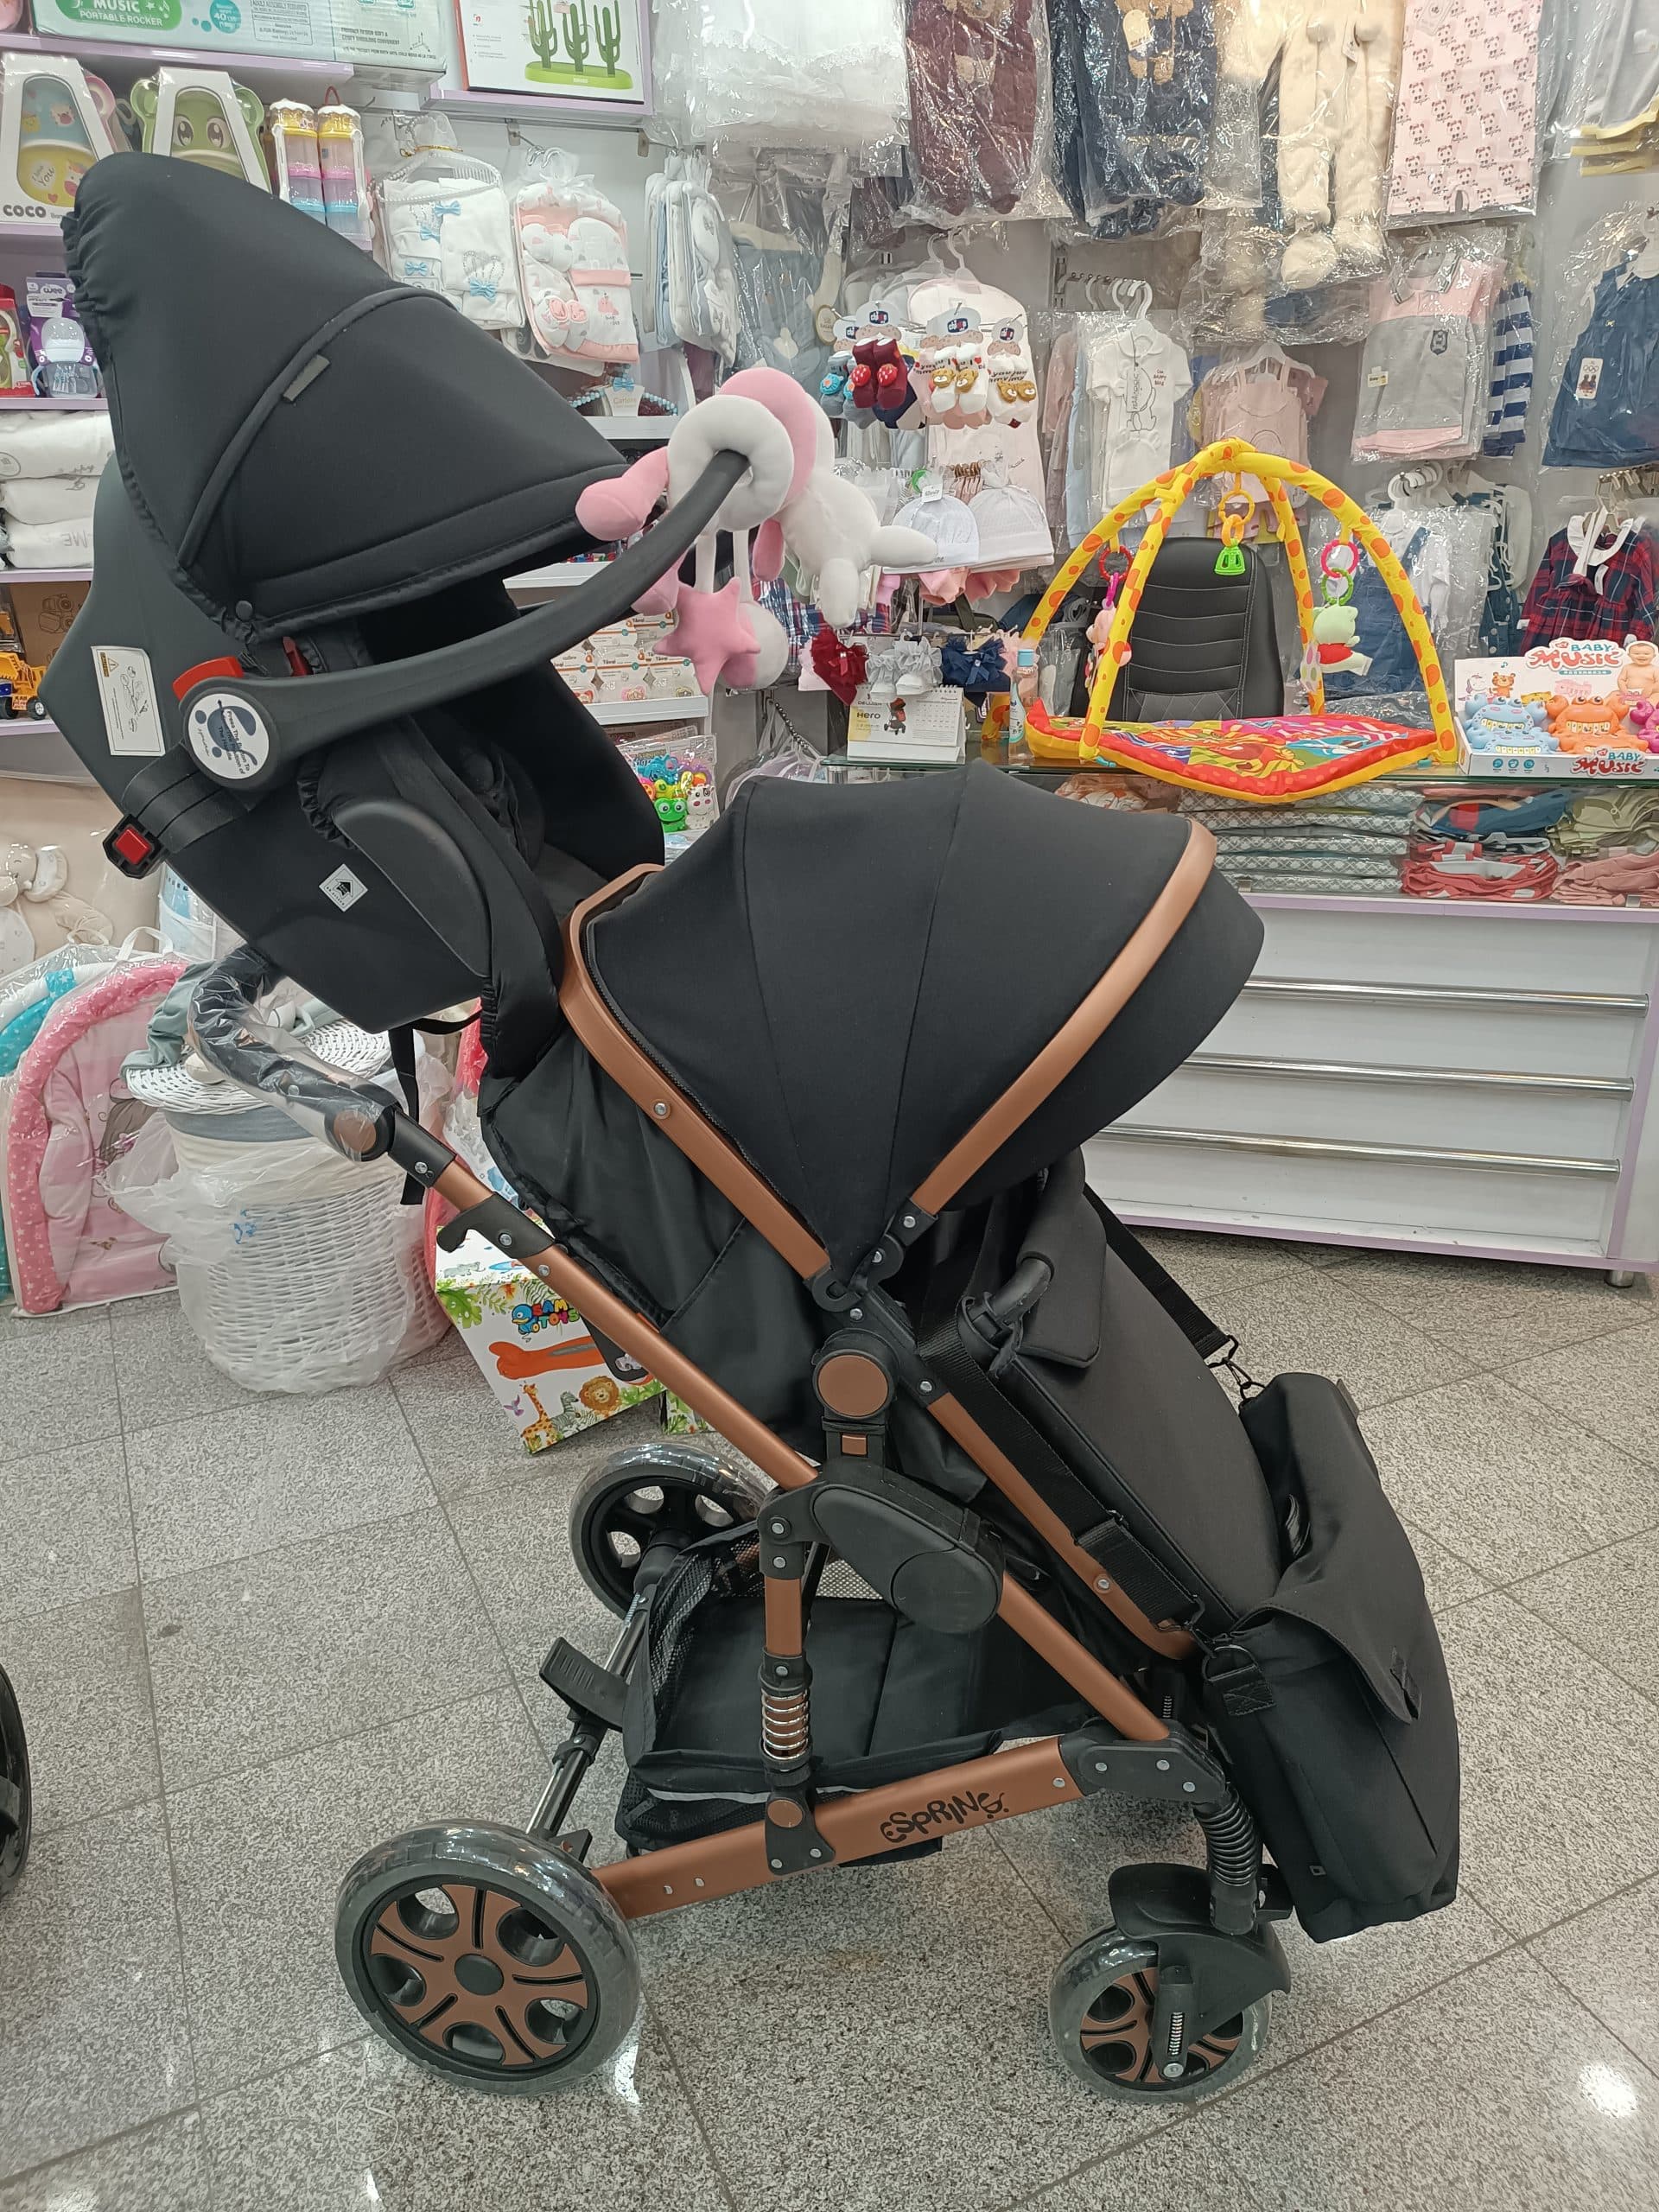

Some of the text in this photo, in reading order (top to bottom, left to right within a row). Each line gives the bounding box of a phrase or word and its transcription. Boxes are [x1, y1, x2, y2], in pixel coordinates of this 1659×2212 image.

[93, 0, 140, 13] MUSIC
[79, 10, 162, 27] PORTABLE ROCKER
[1570, 643, 1612, 652] BABY
[1607, 752, 1641, 760] BABY
